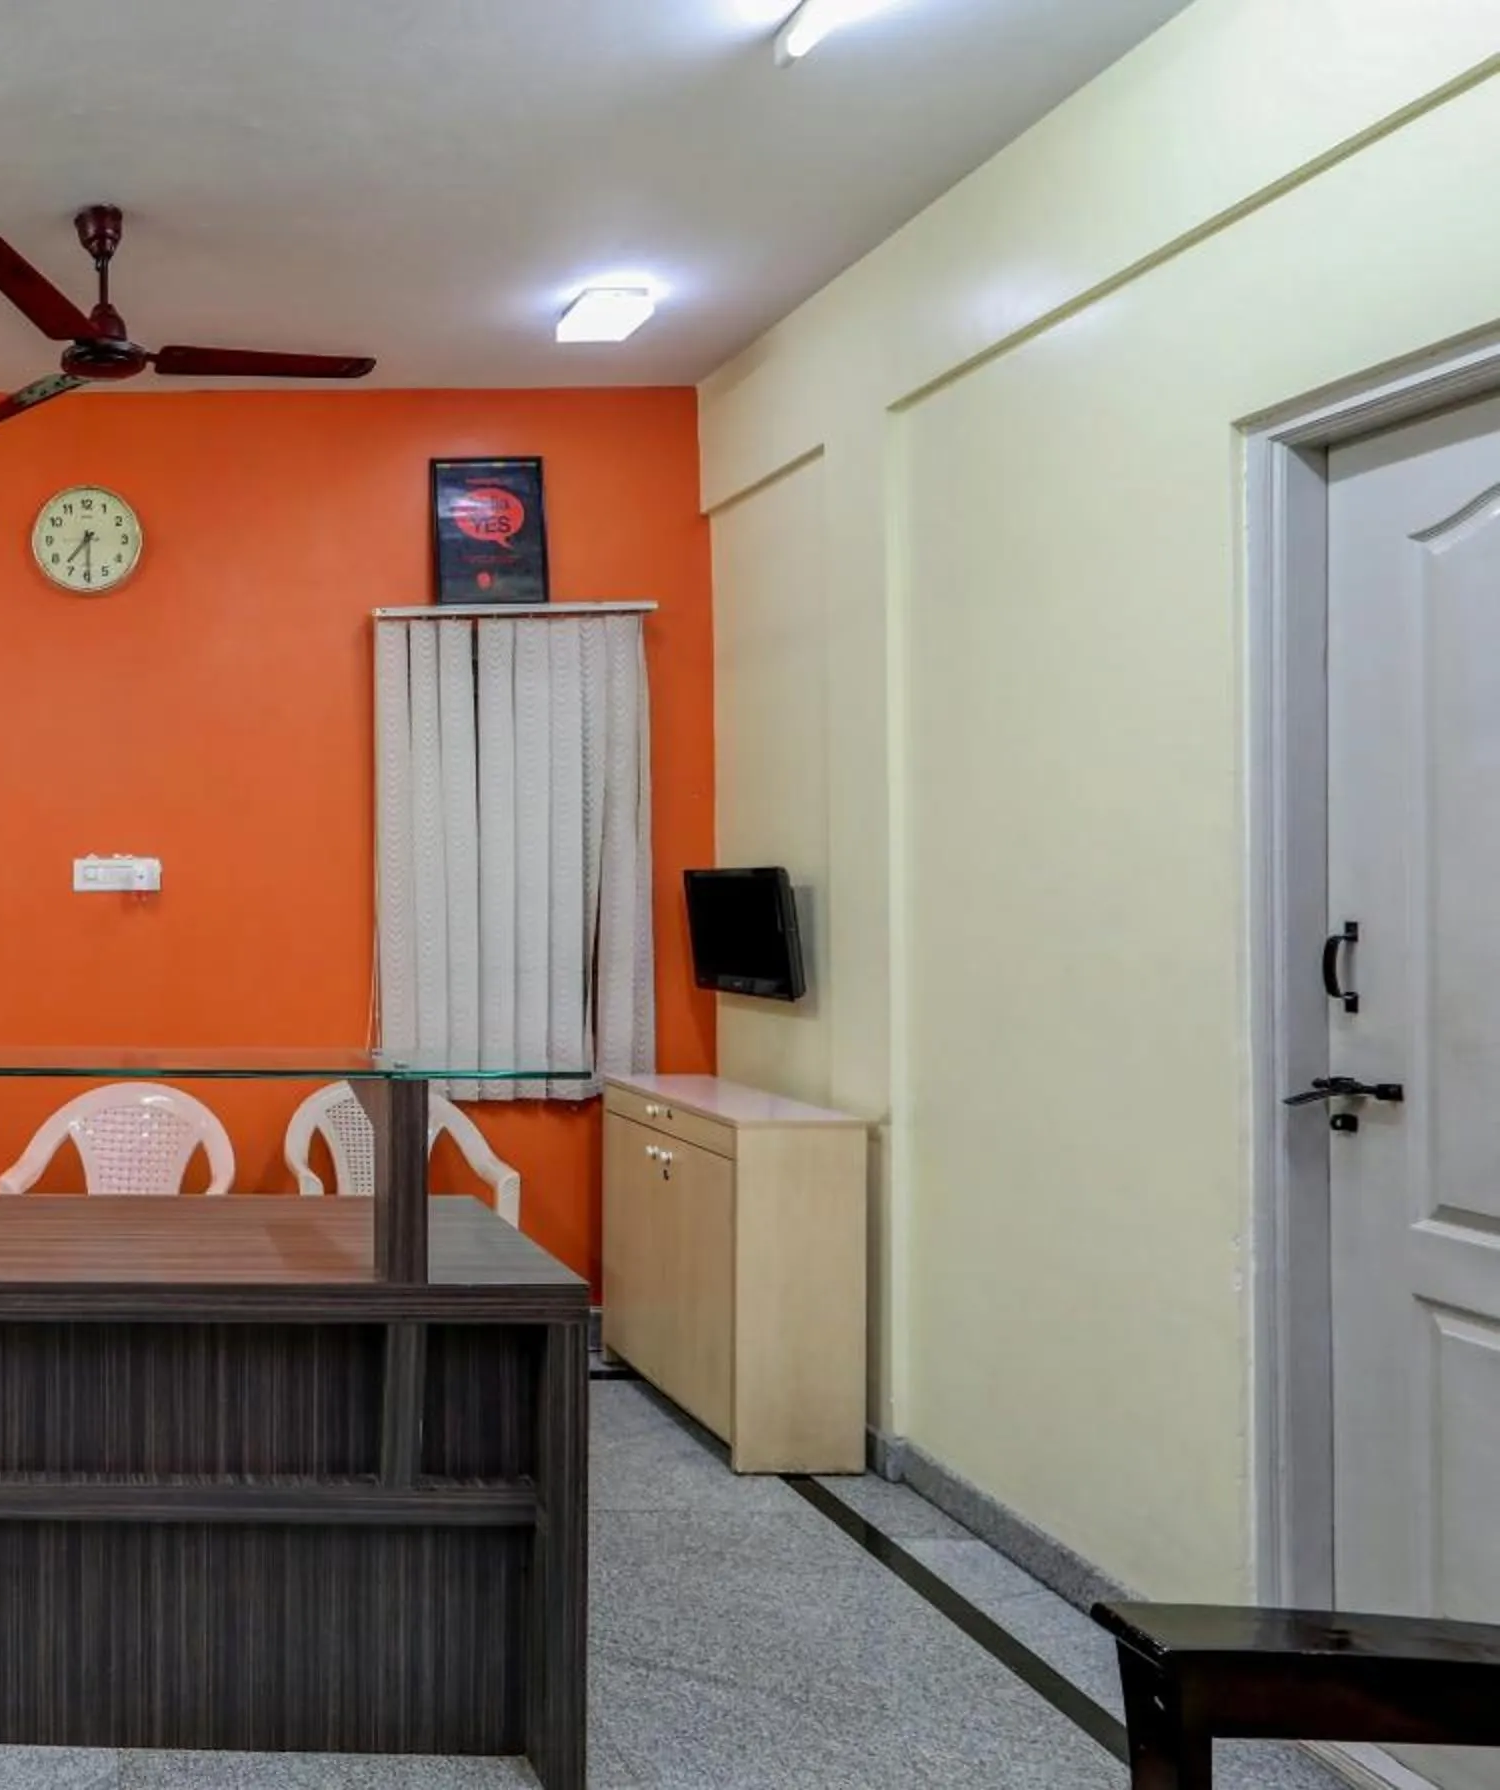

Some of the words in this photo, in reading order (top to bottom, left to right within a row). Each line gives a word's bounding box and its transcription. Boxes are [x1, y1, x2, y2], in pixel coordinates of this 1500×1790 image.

[63, 504, 73, 515] 11
[80, 498, 93, 510] 12
[101, 503, 107, 514] 1
[50, 517, 63, 528] 10
[115, 516, 123, 527] 2
[471, 515, 512, 533] YES
[45, 535, 54, 546] 9
[121, 534, 129, 545] 3
[67, 566, 75, 577] 7
[101, 566, 109, 577] 5
